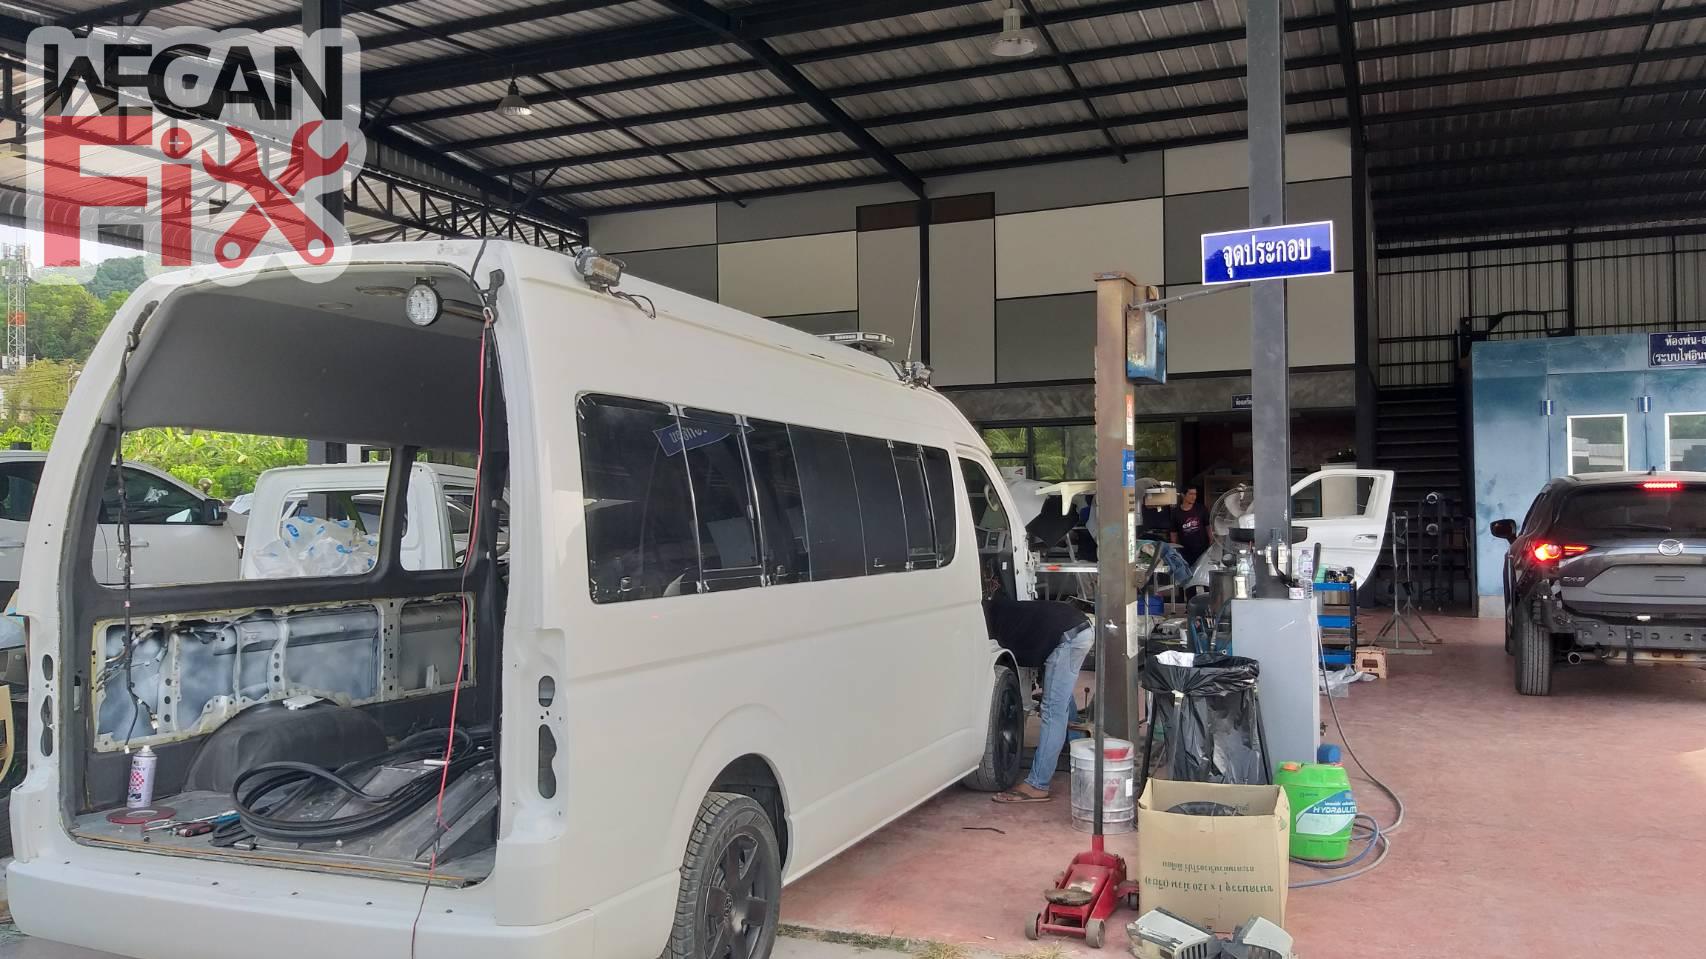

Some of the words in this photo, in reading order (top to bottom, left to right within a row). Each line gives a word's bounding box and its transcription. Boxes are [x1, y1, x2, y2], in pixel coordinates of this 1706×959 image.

[1222, 234, 1312, 279] จุดประกอบ
[1192, 882, 1208, 891] 120
